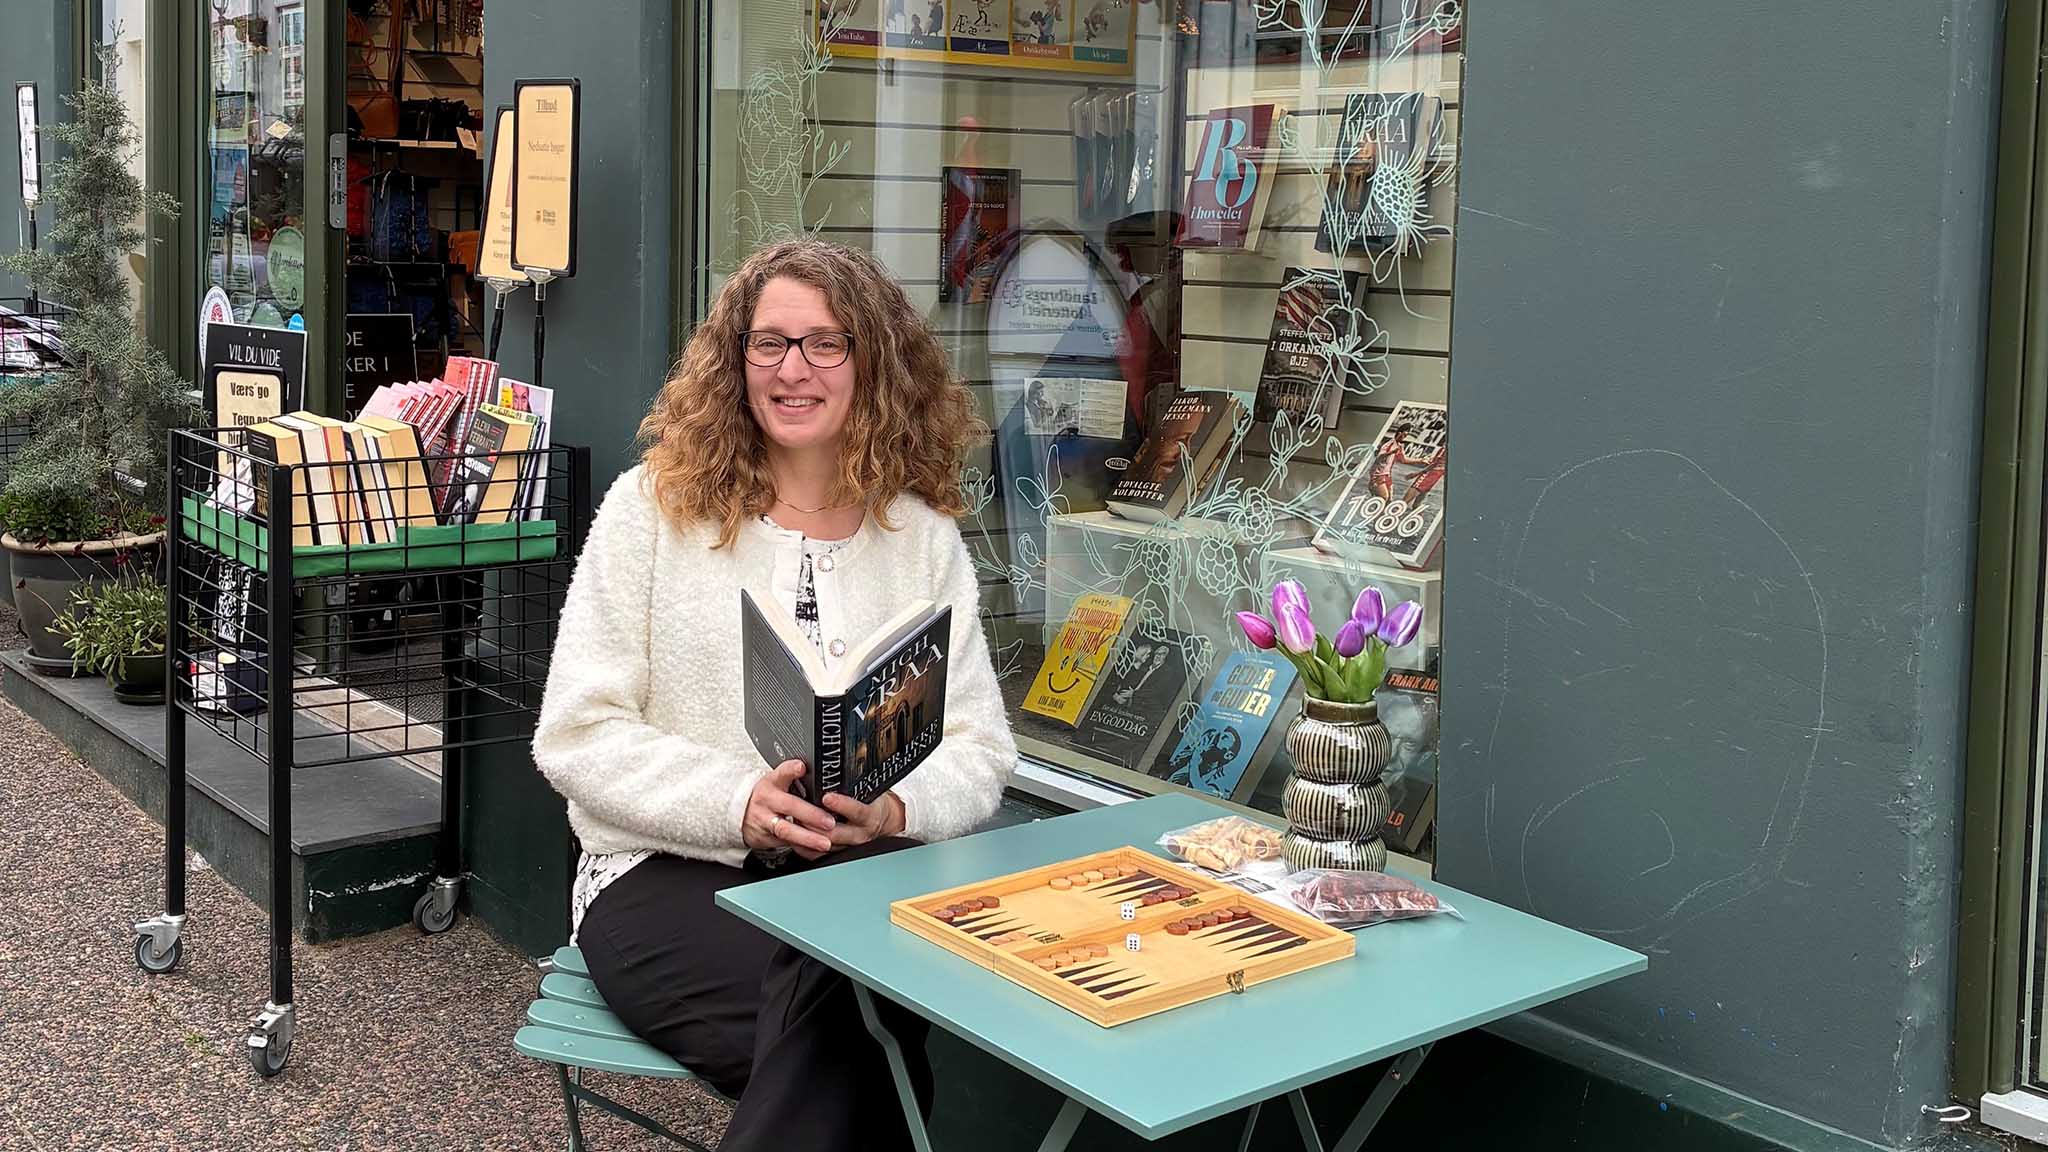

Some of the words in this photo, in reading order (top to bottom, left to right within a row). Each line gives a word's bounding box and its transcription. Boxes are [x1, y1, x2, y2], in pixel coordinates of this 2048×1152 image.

[836, 31, 865, 41] YouTube
[229, 344, 243, 362] VIL
[245, 346, 258, 364] DU
[260, 349, 281, 367] VIDE
[1270, 341, 1276, 351] I
[384, 356, 389, 372] I
[1289, 355, 1309, 367] ØJE
[1172, 397, 1199, 405] JAKOB
[1162, 412, 1193, 421] JENSEN
[1118, 480, 1162, 491] UDVALGTE
[1341, 494, 1431, 537] 1986
[870, 633, 929, 691] MICH
[852, 643, 944, 721] VRAA
[1387, 673, 1421, 689] FRANK
[822, 703, 841, 746] MICH
[1090, 711, 1105, 722] EN
[1103, 713, 1124, 729] GOD
[1123, 719, 1149, 737] DAG
[853, 768, 878, 798] JEG
[882, 752, 901, 772] ER
[904, 718, 939, 754] IKKE
[822, 748, 841, 791] VRAA
